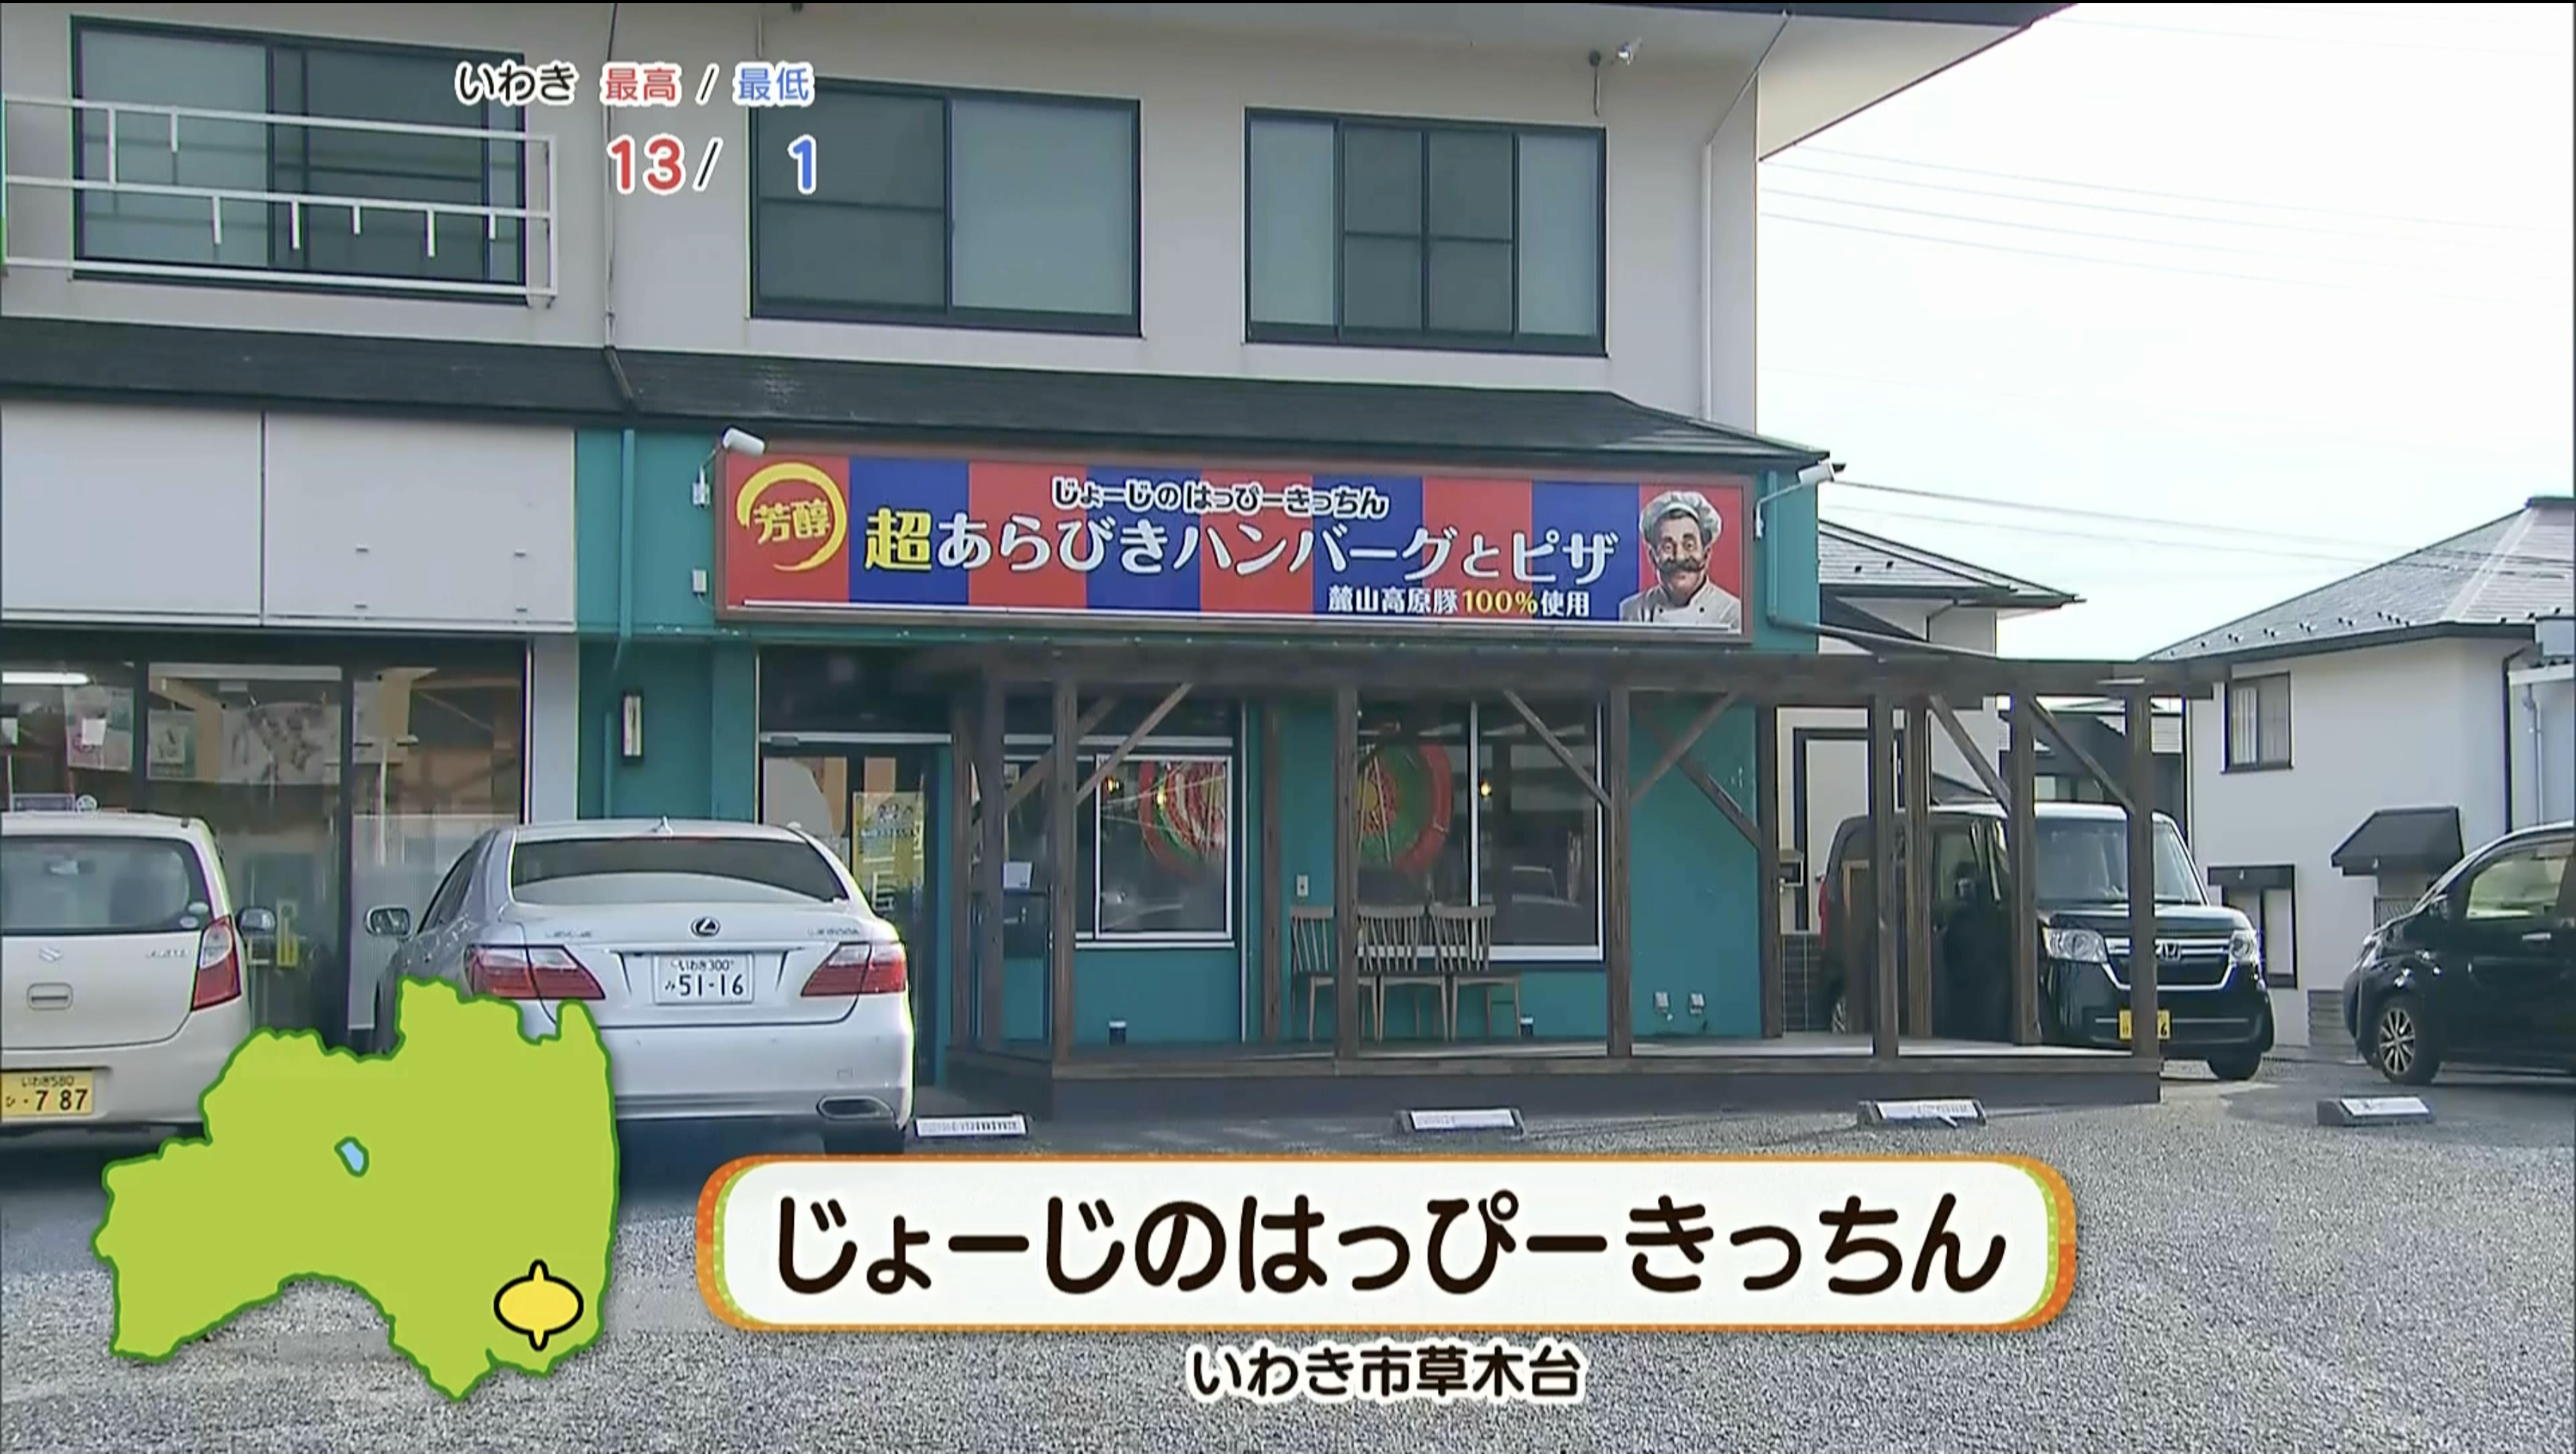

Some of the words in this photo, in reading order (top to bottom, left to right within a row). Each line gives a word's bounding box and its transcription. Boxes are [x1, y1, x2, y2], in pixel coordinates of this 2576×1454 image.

[1054, 478, 1387, 518] じょーじのはっぴーきっちん
[752, 497, 829, 544] 芳醇
[864, 508, 1619, 585] 超あらびきハンバーグとピザ
[679, 973, 744, 996] 51-16
